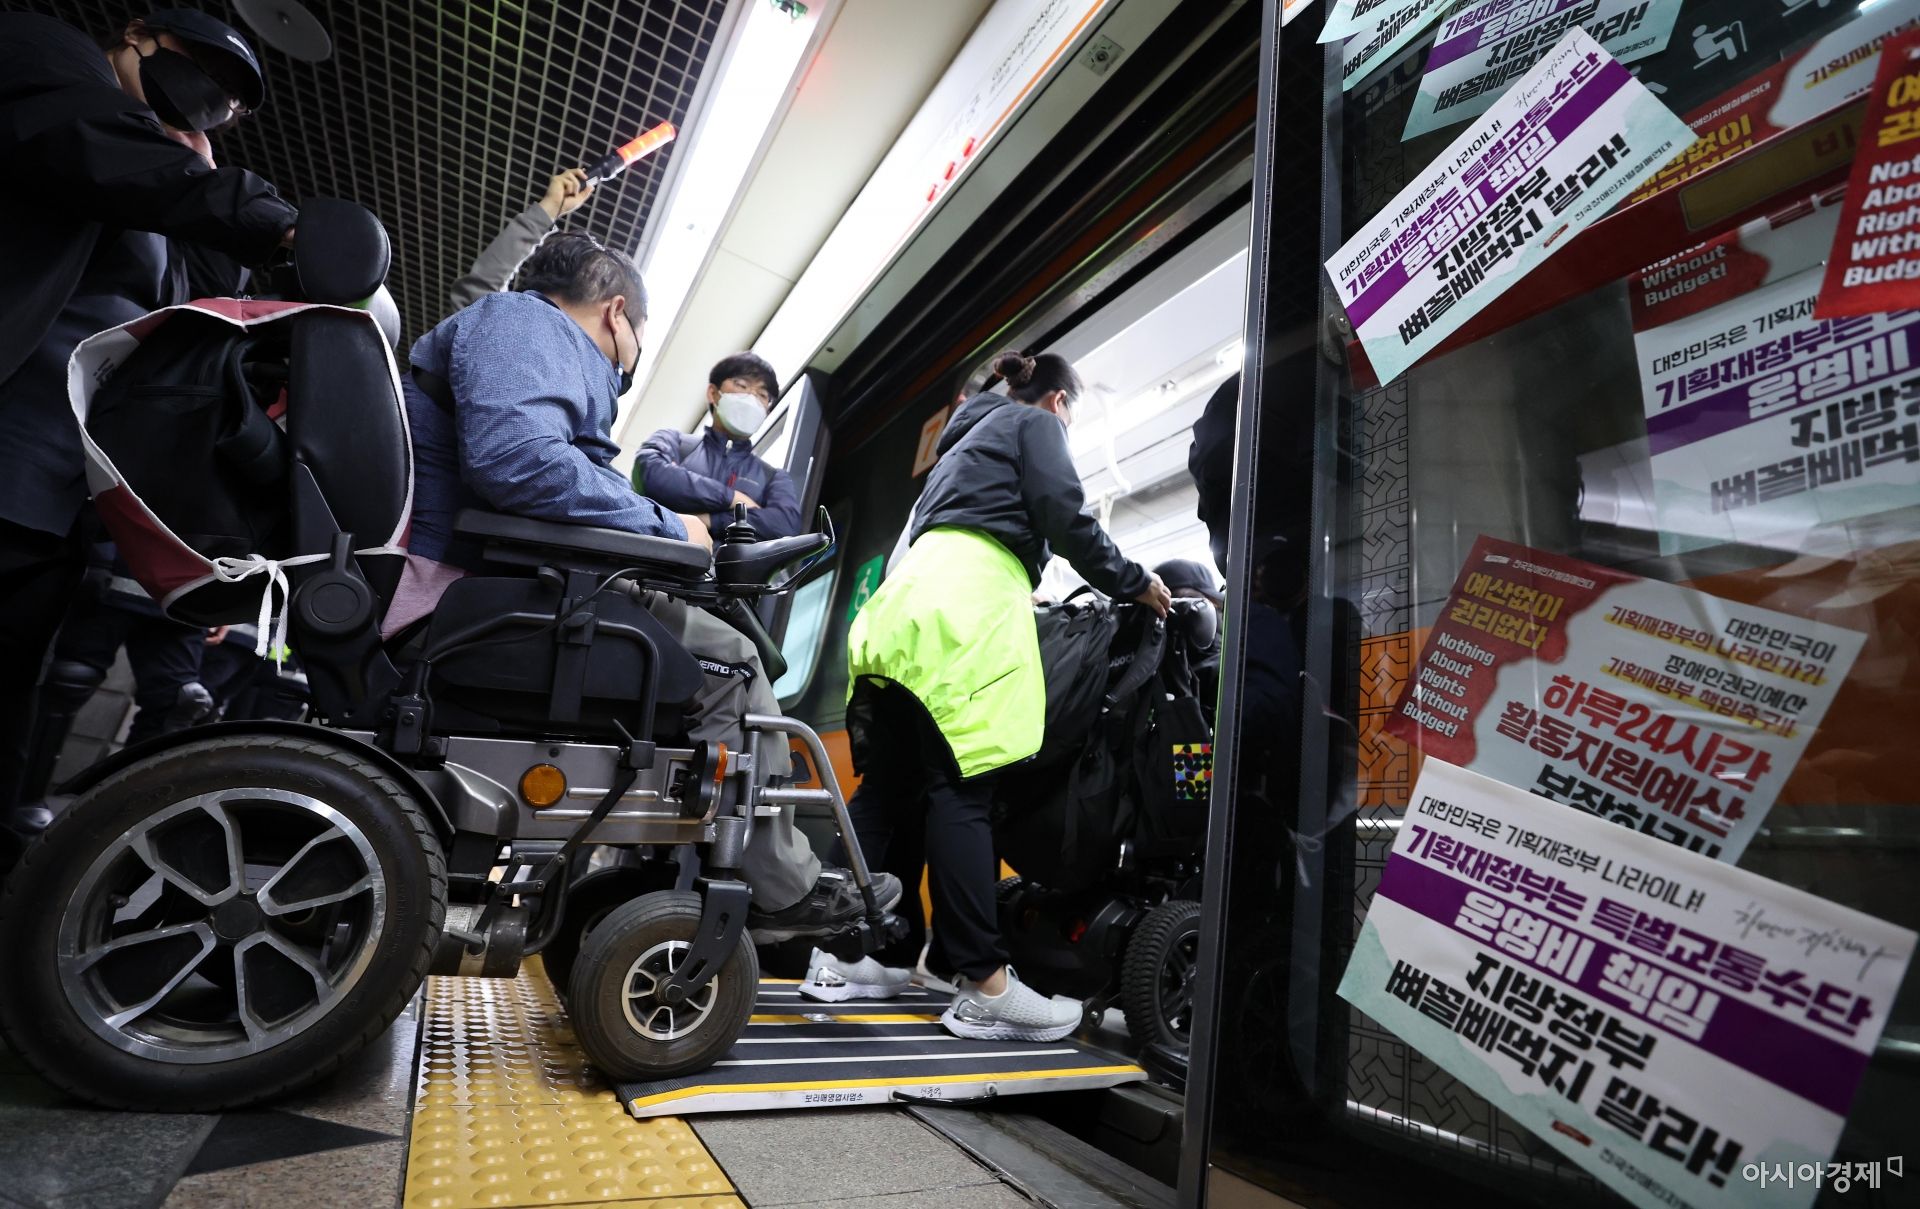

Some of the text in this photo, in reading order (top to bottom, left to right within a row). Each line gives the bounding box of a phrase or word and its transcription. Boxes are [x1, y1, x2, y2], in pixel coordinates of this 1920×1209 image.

[1340, 119, 1502, 281] 대한민국은 기획재정부 나라이냐!
[1346, 187, 1461, 298] 기획재정부는
[1461, 52, 1602, 189] 특별교통수단
[1401, 189, 1487, 278] 운영비
[1489, 125, 1557, 193] 책임
[1432, 166, 1551, 280] 지방정부
[1641, 244, 1727, 291] Without
[1644, 264, 1727, 307] Budget!
[1652, 325, 1748, 375] 대한민국은
[1748, 329, 1910, 420] 운영비
[1463, 571, 1566, 622] 예산없이
[1450, 598, 1548, 649] 권리없다
[1611, 606, 1714, 651] 기획재정부의
[1724, 618, 1838, 664] 대한민국이
[1428, 650, 1474, 679] About
[1437, 632, 1495, 667] Nothing
[1411, 685, 1469, 721] Without
[1420, 666, 1466, 697] Rights
[1608, 656, 1696, 700] 기획재정부
[1663, 654, 1809, 715] 장애인권리예산
[1402, 701, 1459, 739] Budget!
[1543, 673, 1773, 793] 하루24시간
[1496, 700, 1746, 839] 활동지원예산
[1418, 796, 1707, 913] 대한민국은 기획재정부 나라이냐!
[1407, 825, 1873, 1037] 기획재정부는 특별교통수단
[1454, 891, 1721, 1042] 운영비 책임
[1466, 952, 1658, 1071] 지방정부
